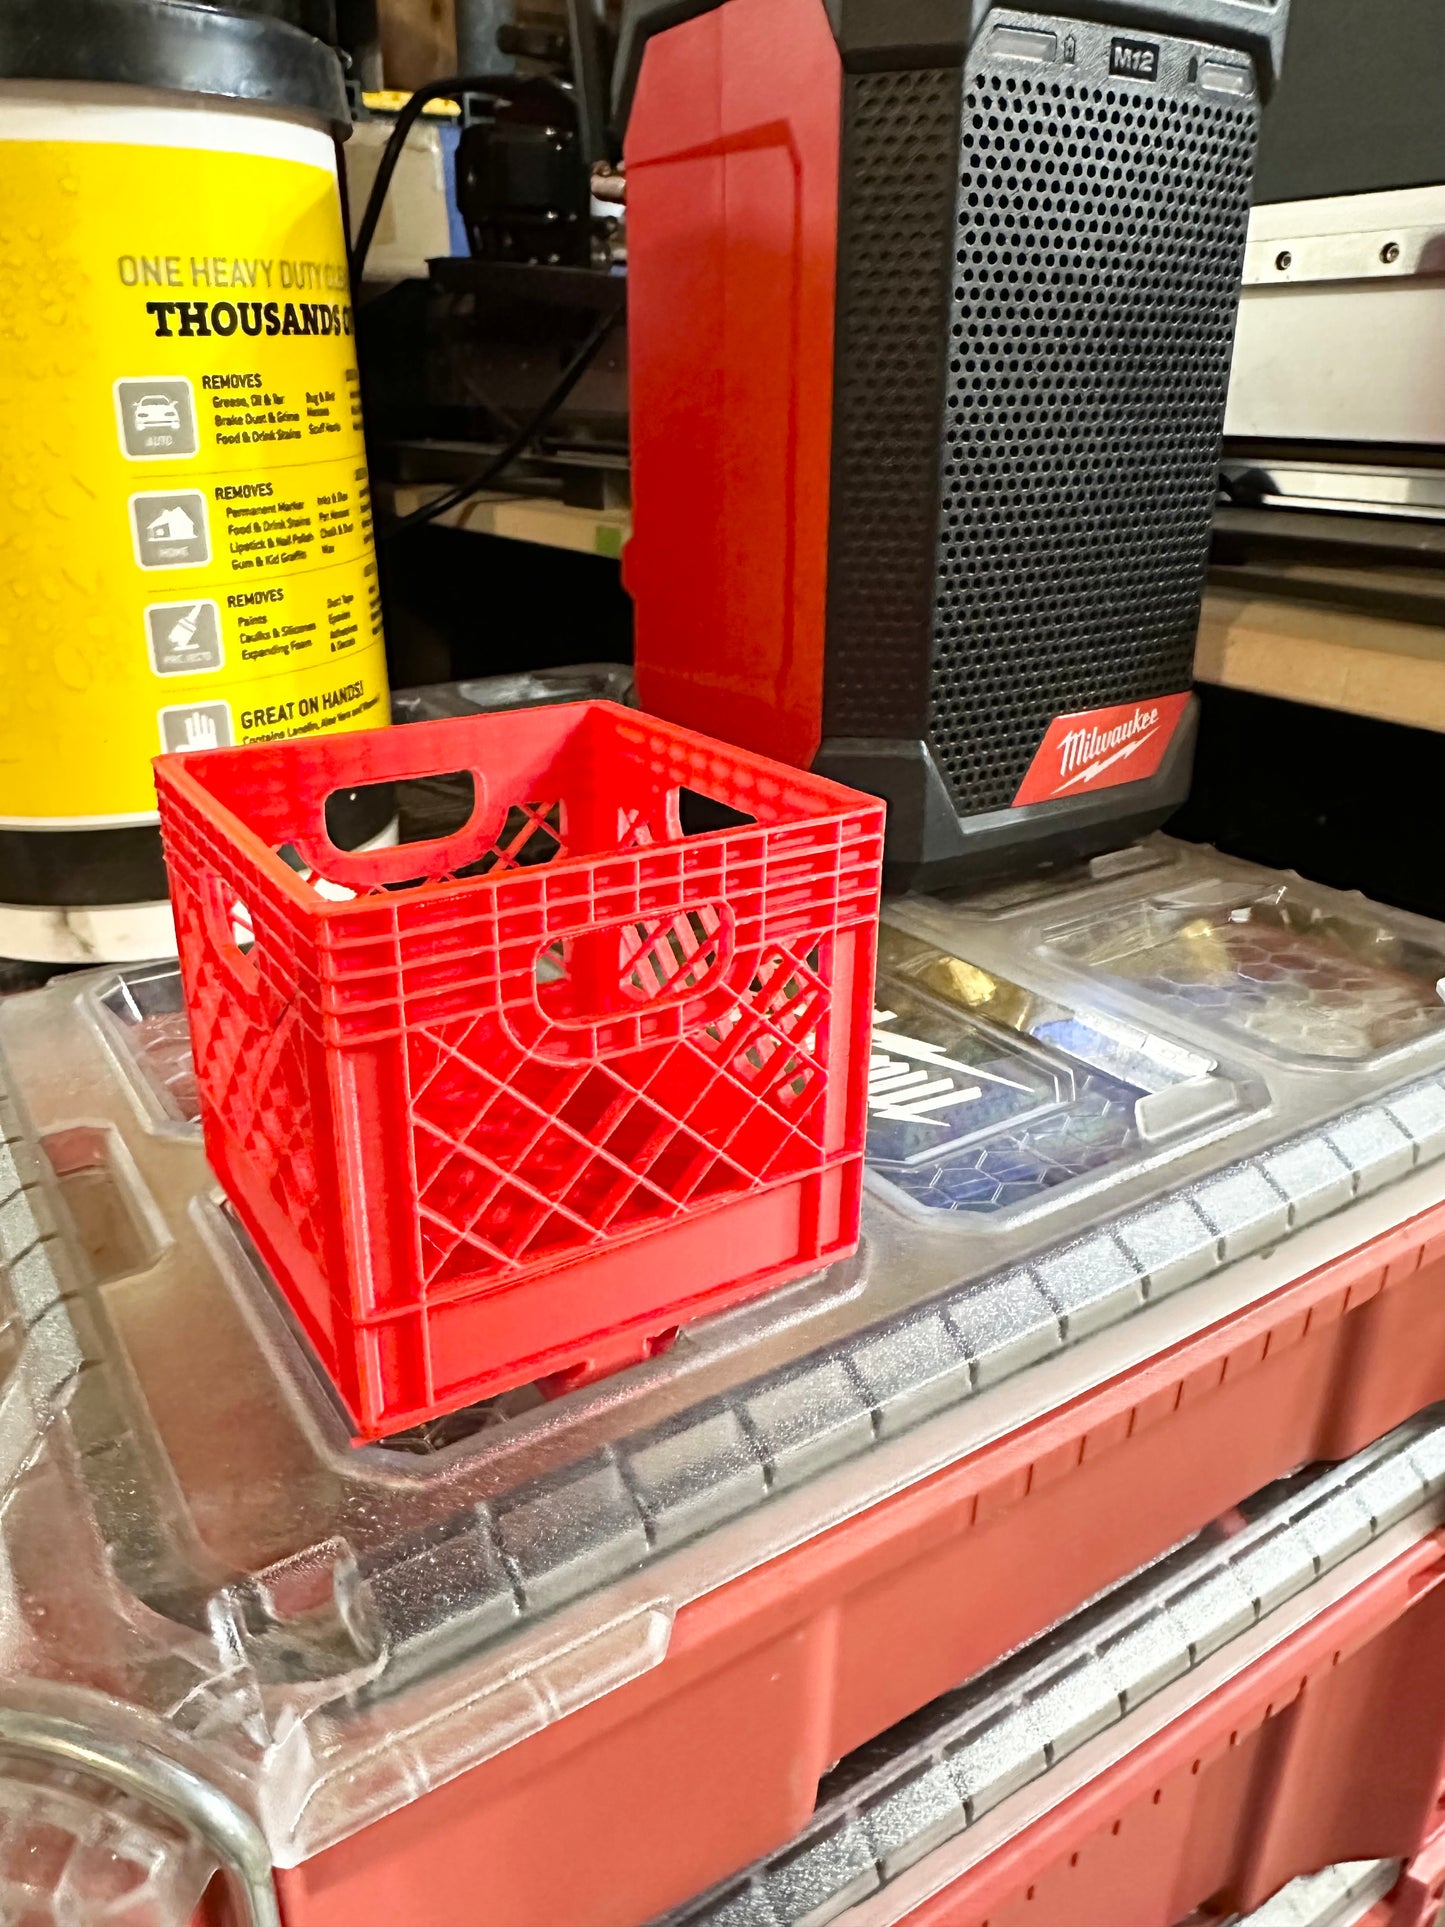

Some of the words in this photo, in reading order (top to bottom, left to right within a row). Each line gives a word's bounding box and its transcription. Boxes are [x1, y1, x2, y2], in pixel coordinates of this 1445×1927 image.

[1114, 45, 1155, 72] M12
[118, 254, 184, 287] ONE
[190, 256, 273, 288] HEAVY
[279, 259, 322, 290] DUTY
[146, 301, 342, 337] THOUSANDS
[202, 373, 263, 390] REMOVES
[214, 414, 244, 427] Brake
[267, 411, 276, 424] &
[216, 432, 241, 444] Food
[241, 431, 251, 443] &
[251, 431, 276, 443] Drink
[214, 482, 274, 501] REMOVES
[226, 504, 276, 519] Permanent
[228, 523, 252, 536] Food
[252, 521, 262, 533] &
[262, 519, 286, 532] Drink
[229, 539, 266, 555] Lipstick
[267, 537, 275, 549] &
[231, 559, 254, 571] Gum
[255, 556, 264, 567] &
[227, 588, 284, 608] REMOVES
[238, 615, 267, 627] Paints
[240, 702, 295, 729] GREAT
[298, 696, 319, 717] ON
[321, 680, 364, 710] HANDS!
[242, 729, 286, 746] Contains
[1056, 708, 1160, 777] Milwaukee
